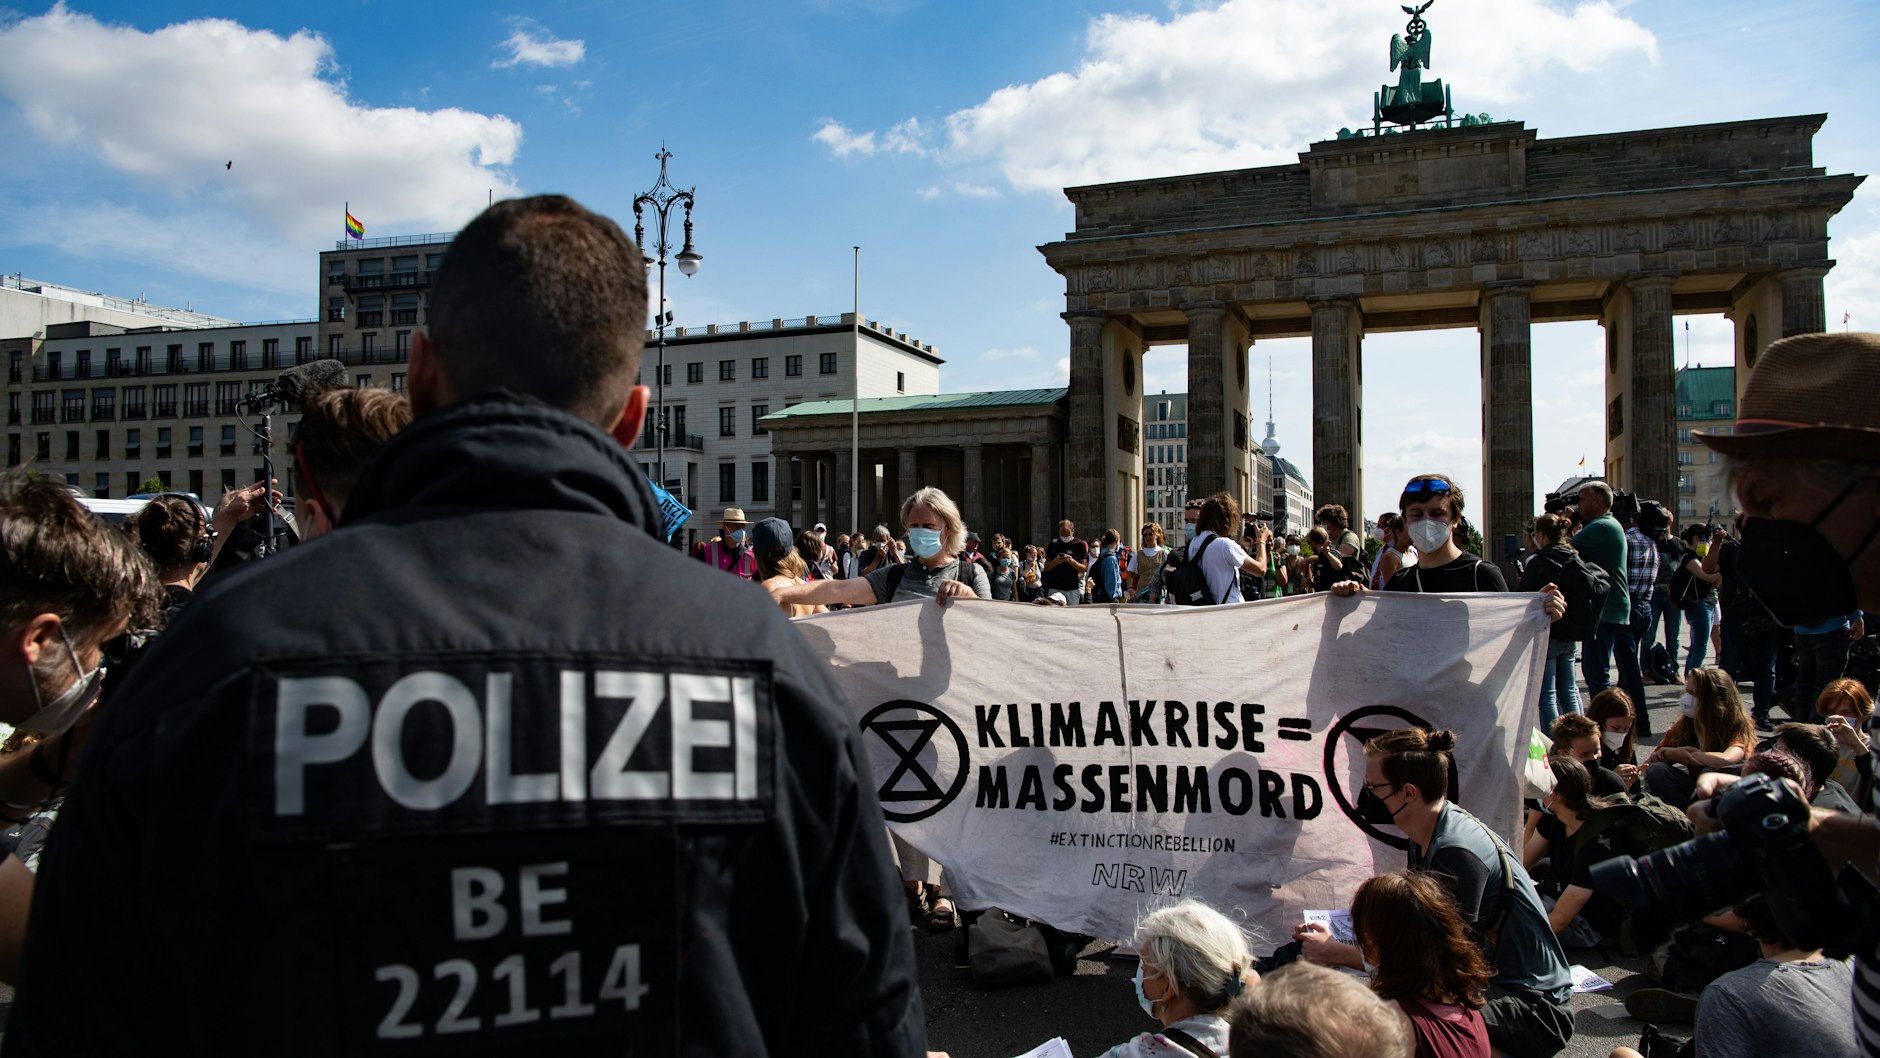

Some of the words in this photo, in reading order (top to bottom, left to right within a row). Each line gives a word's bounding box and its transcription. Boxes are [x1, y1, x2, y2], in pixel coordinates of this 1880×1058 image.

[275, 670, 759, 817] POLIZEI
[975, 699, 1266, 753] KLIMAKRISE
[974, 763, 1324, 820] MASSENMORD
[1050, 832, 1236, 853] #EXTINCTIONREBELLION
[451, 861, 573, 941] BE
[1091, 862, 1188, 898] NRW
[374, 943, 650, 1040] 22114
